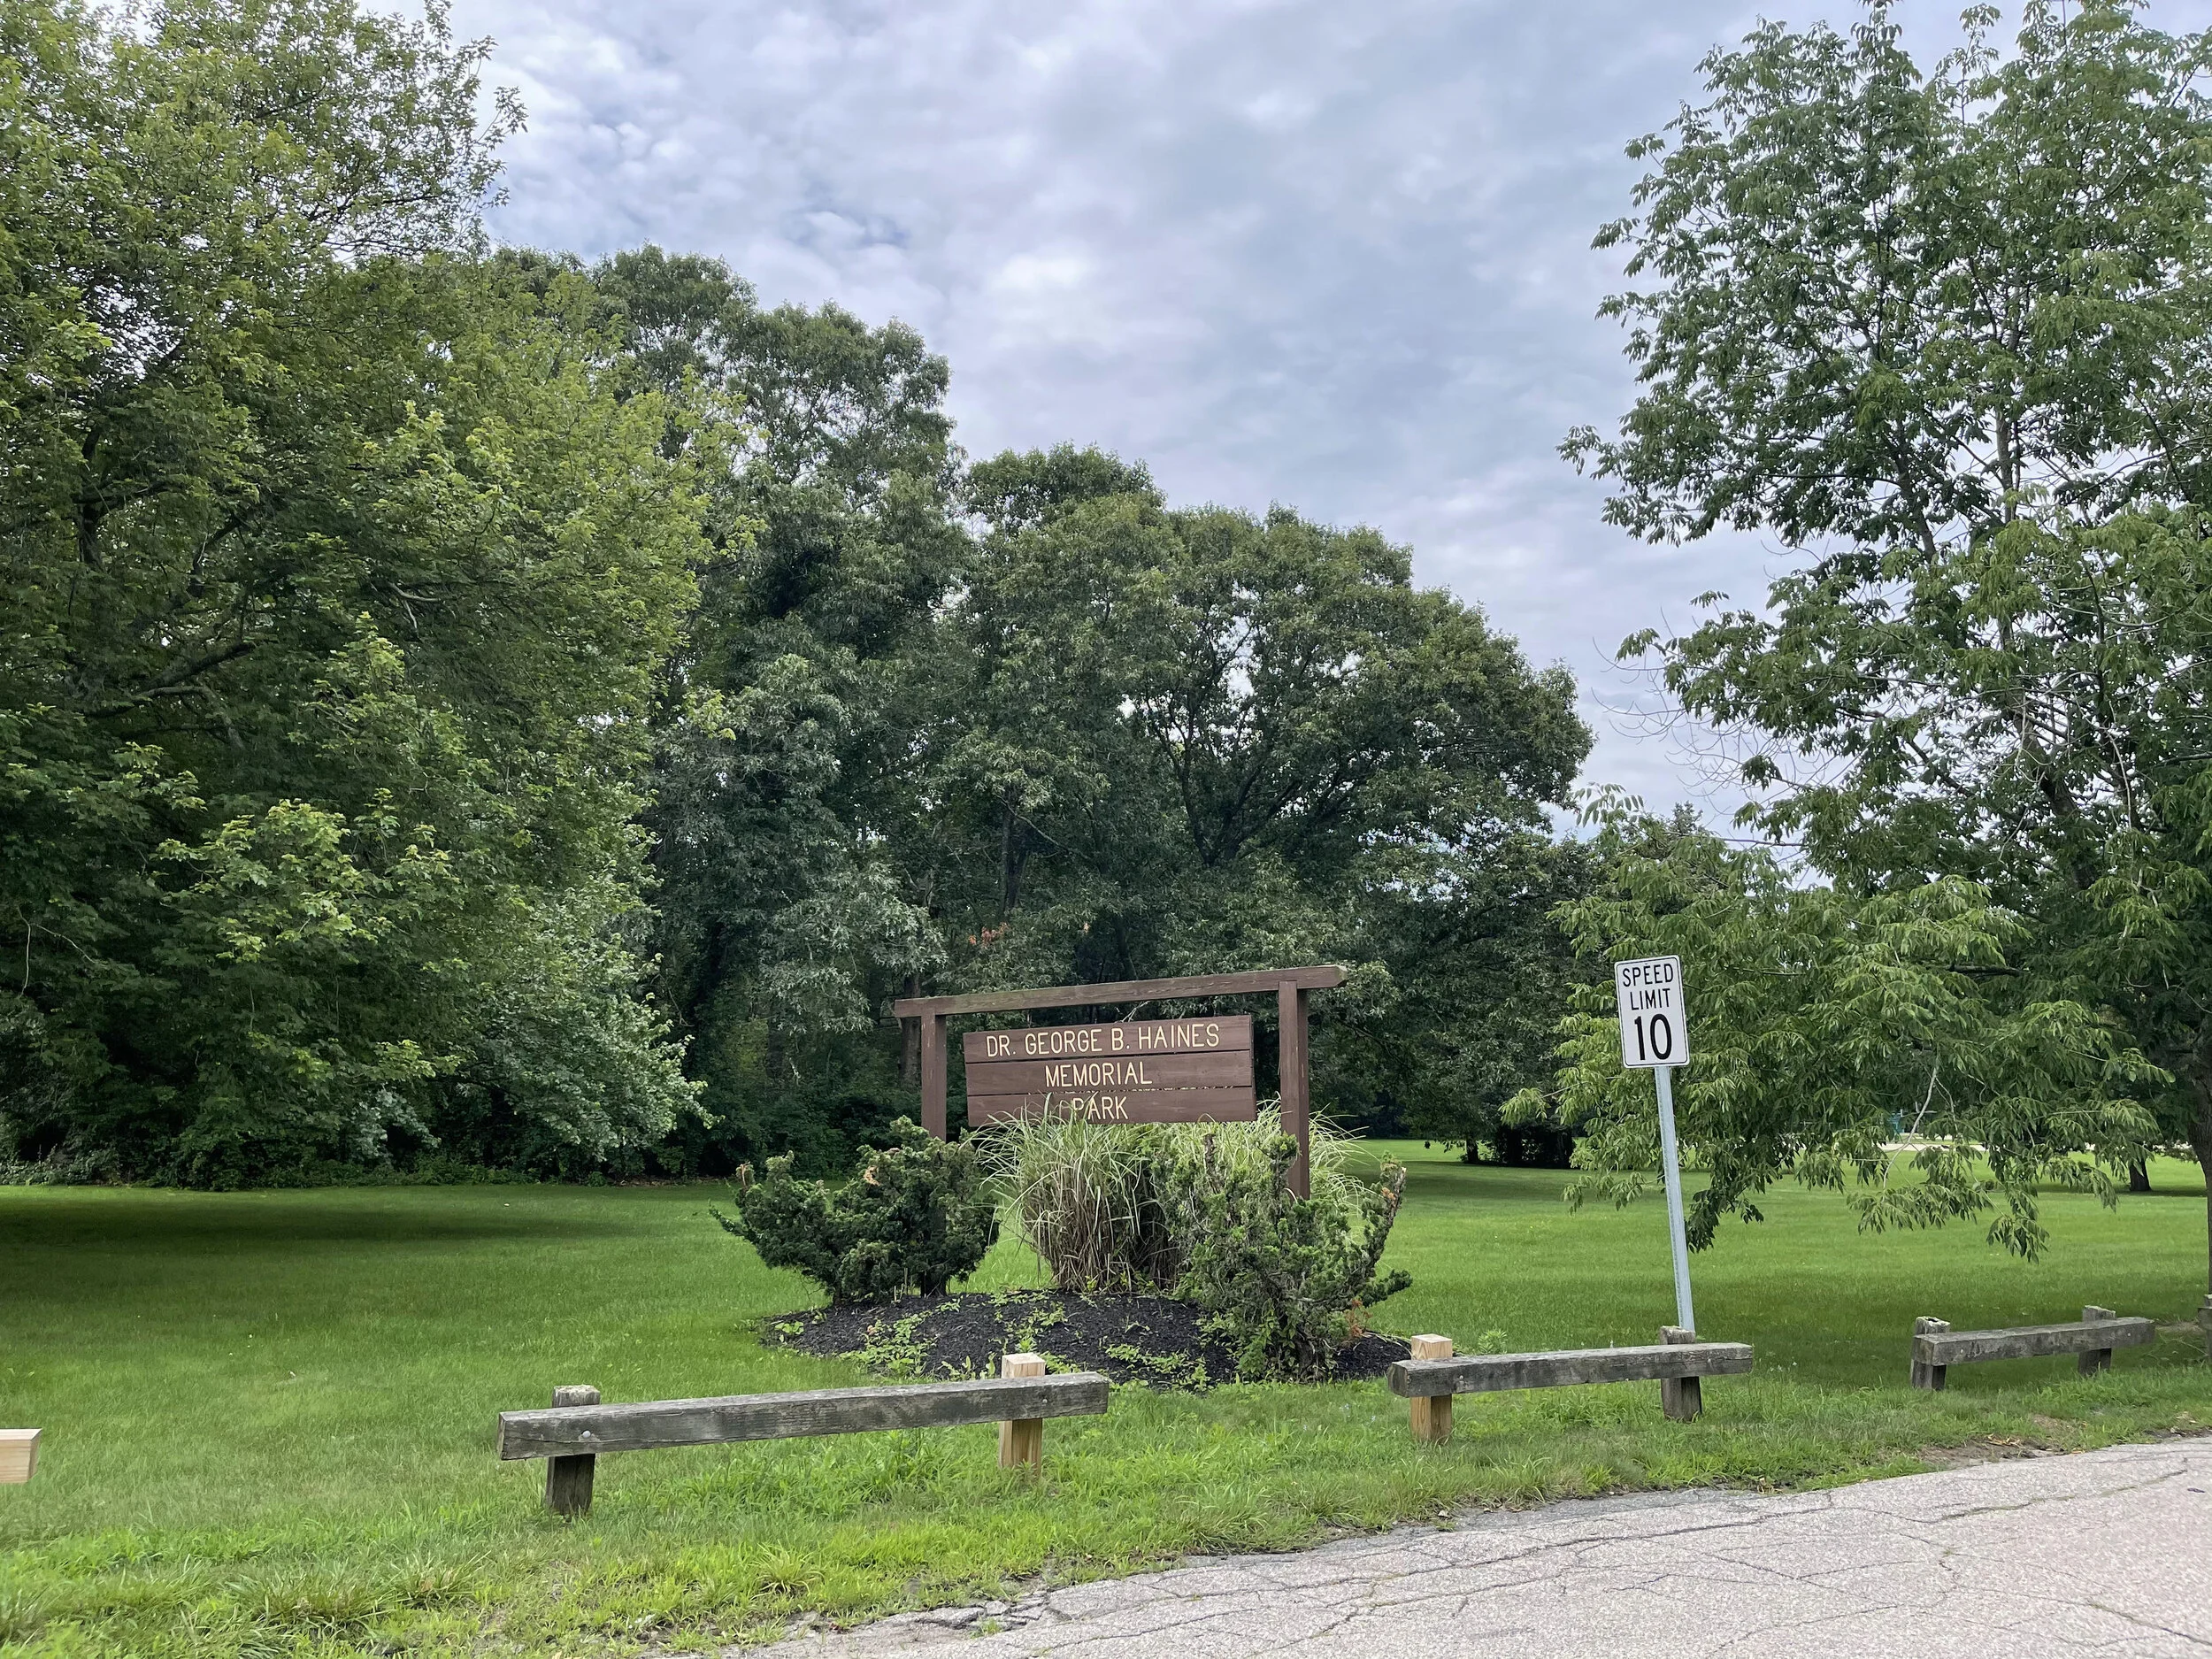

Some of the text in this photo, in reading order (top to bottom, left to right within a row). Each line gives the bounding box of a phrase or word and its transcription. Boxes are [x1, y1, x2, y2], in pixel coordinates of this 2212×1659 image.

[1623, 964, 1673, 987] SPEED
[1630, 988, 1671, 1010] LIMIT
[986, 1023, 1220, 1057] DR. GEORGE B. HAINES
[1634, 1013, 1672, 1061] 10
[1045, 1062, 1153, 1088] MEMORIAL
[1072, 1095, 1129, 1121] PARK
